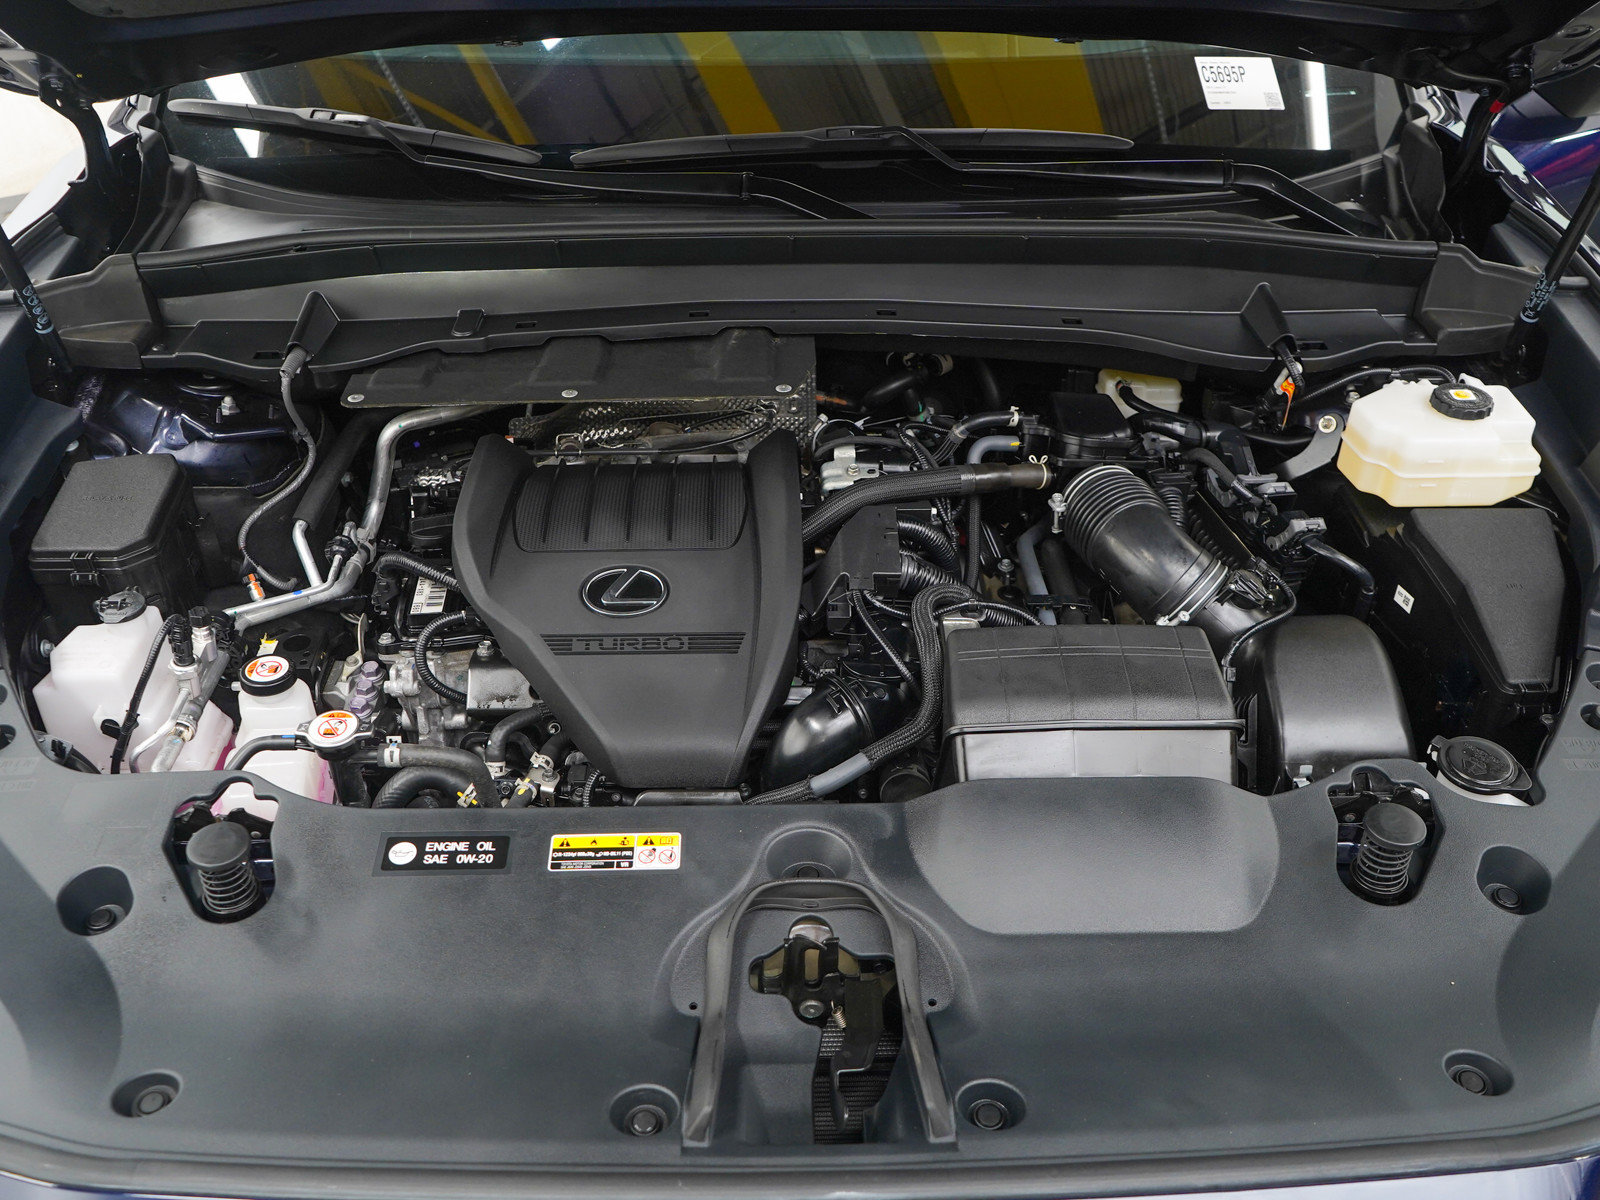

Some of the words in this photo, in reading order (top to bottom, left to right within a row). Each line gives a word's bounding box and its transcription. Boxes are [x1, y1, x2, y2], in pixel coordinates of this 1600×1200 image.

[1201, 65, 1246, 83] C5695P
[576, 636, 685, 651] TURBO
[425, 841, 470, 852] ENGINE
[476, 841, 496, 852] OIL
[423, 854, 448, 865] SAE
[456, 853, 494, 864] 0W-20
